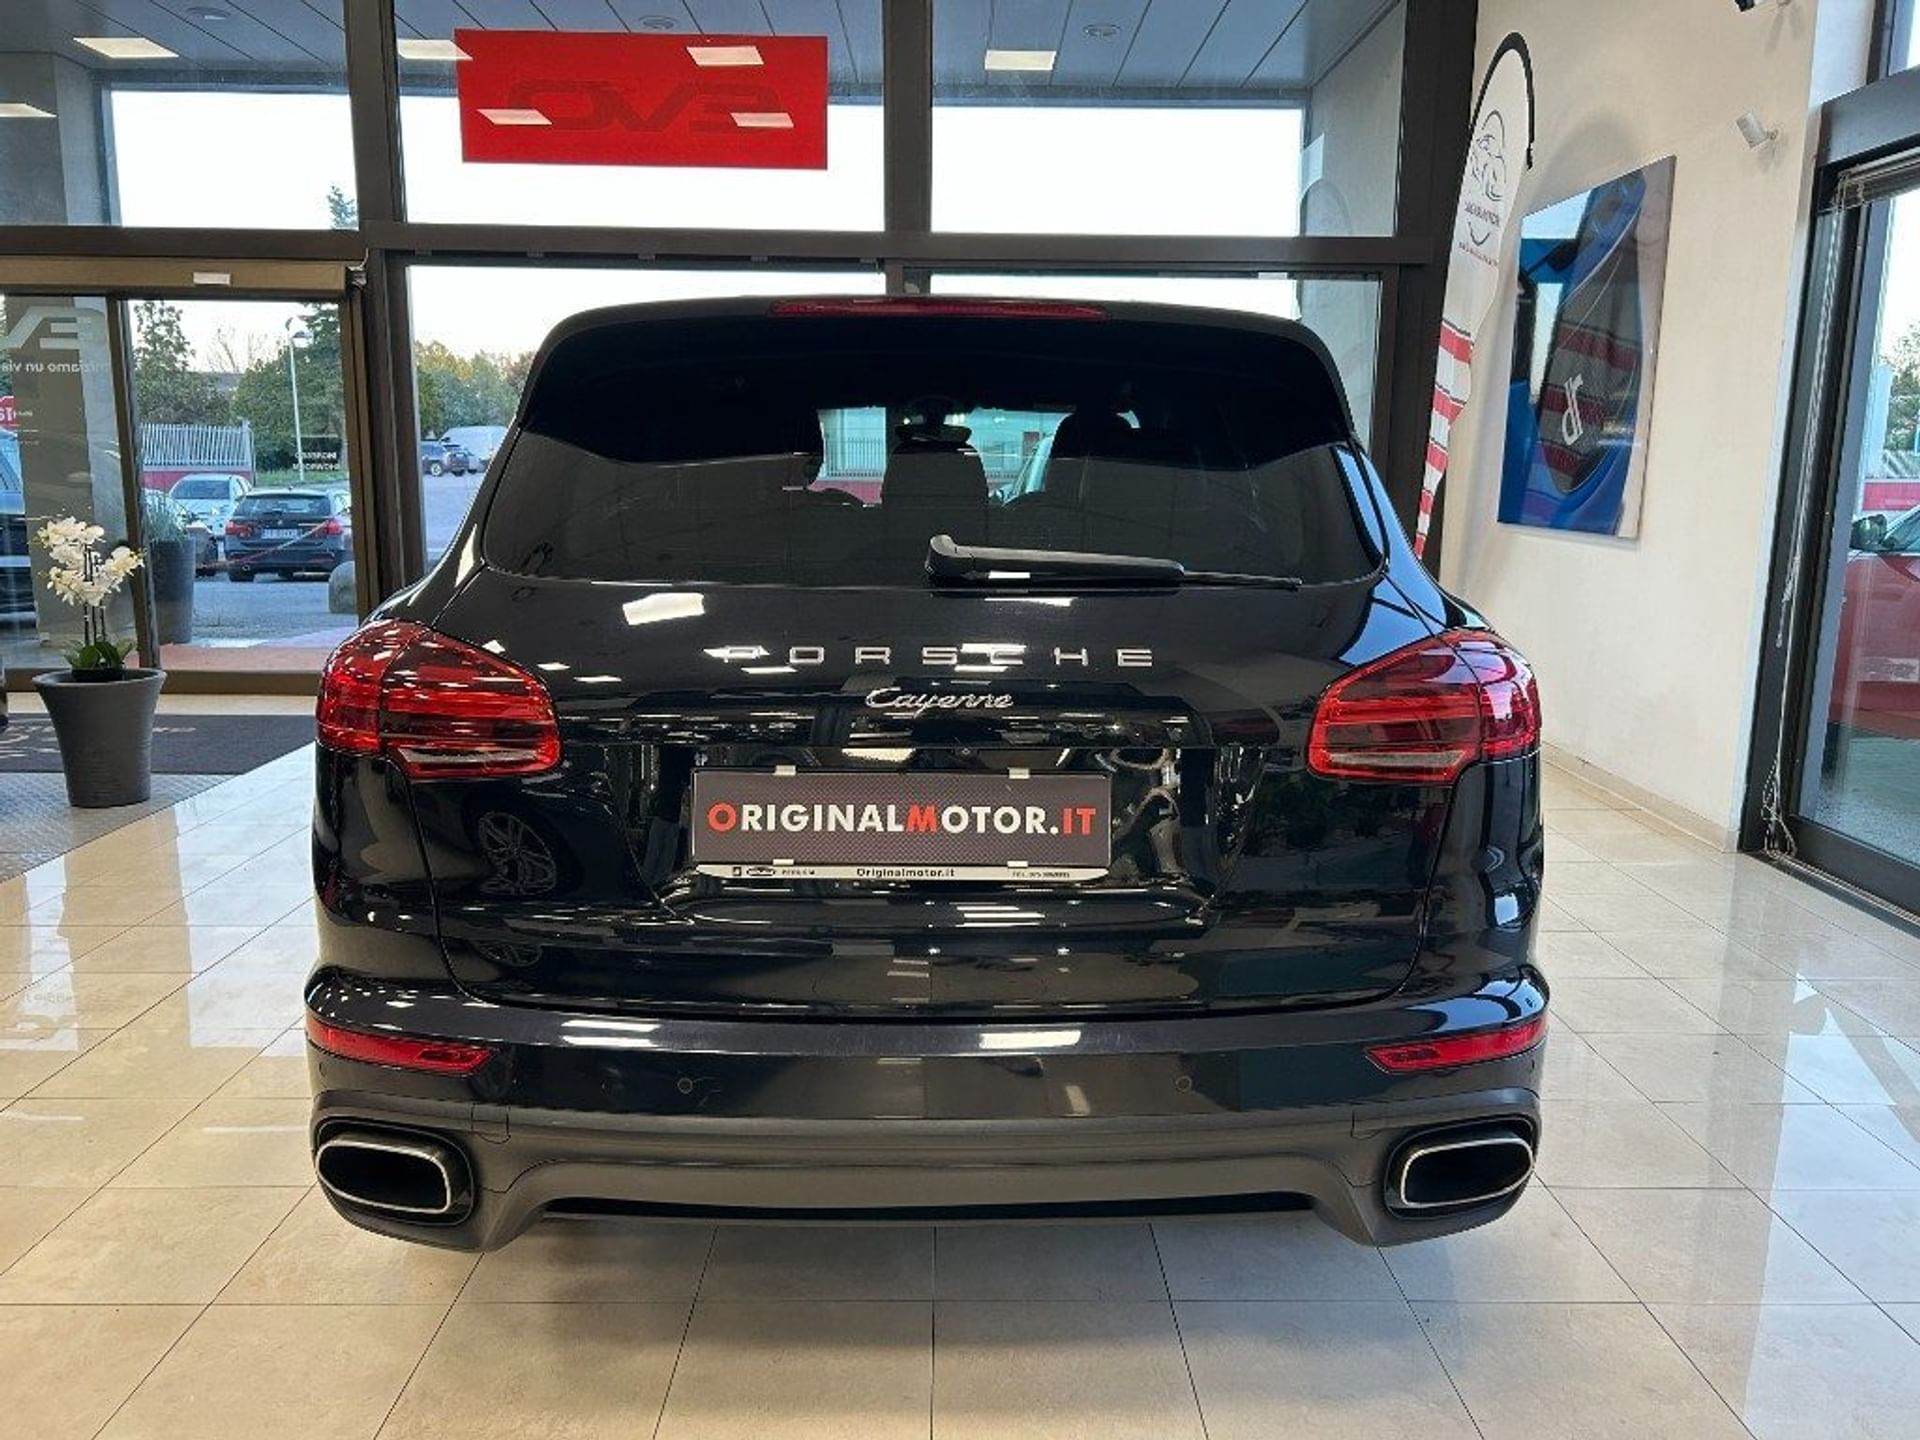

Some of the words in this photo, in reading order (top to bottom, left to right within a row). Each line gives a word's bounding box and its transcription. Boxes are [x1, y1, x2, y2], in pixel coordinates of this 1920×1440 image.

[725, 645, 1153, 667] PORSCHE
[866, 686, 1014, 717] Cayenne
[706, 802, 1097, 836] ORIGINALMOTOR.IT
[856, 868, 955, 878] Originalmotor.it
